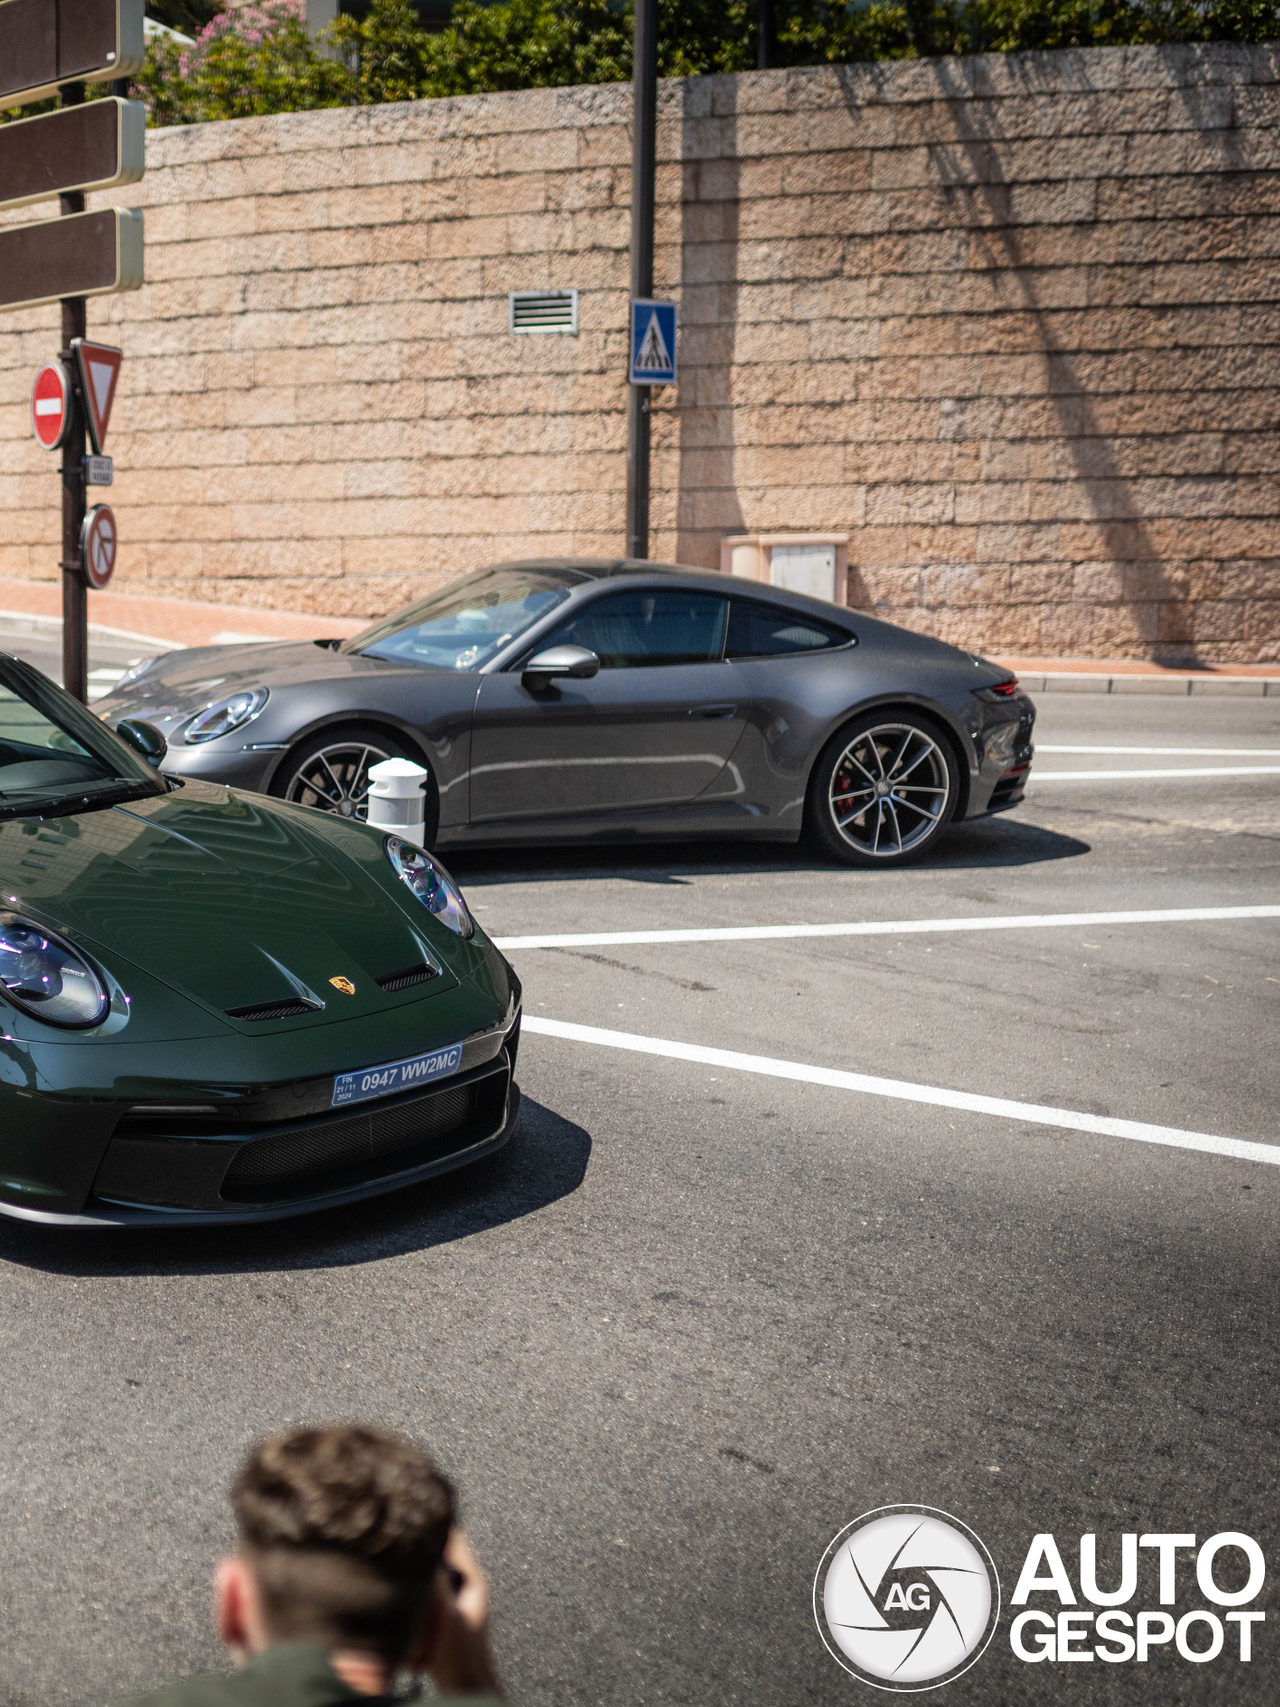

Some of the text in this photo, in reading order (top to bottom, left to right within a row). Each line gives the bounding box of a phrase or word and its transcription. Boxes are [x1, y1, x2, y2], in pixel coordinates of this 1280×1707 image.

[341, 1076, 353, 1084] FIN
[361, 1069, 399, 1091] 0947
[401, 1050, 458, 1081] WW2MC
